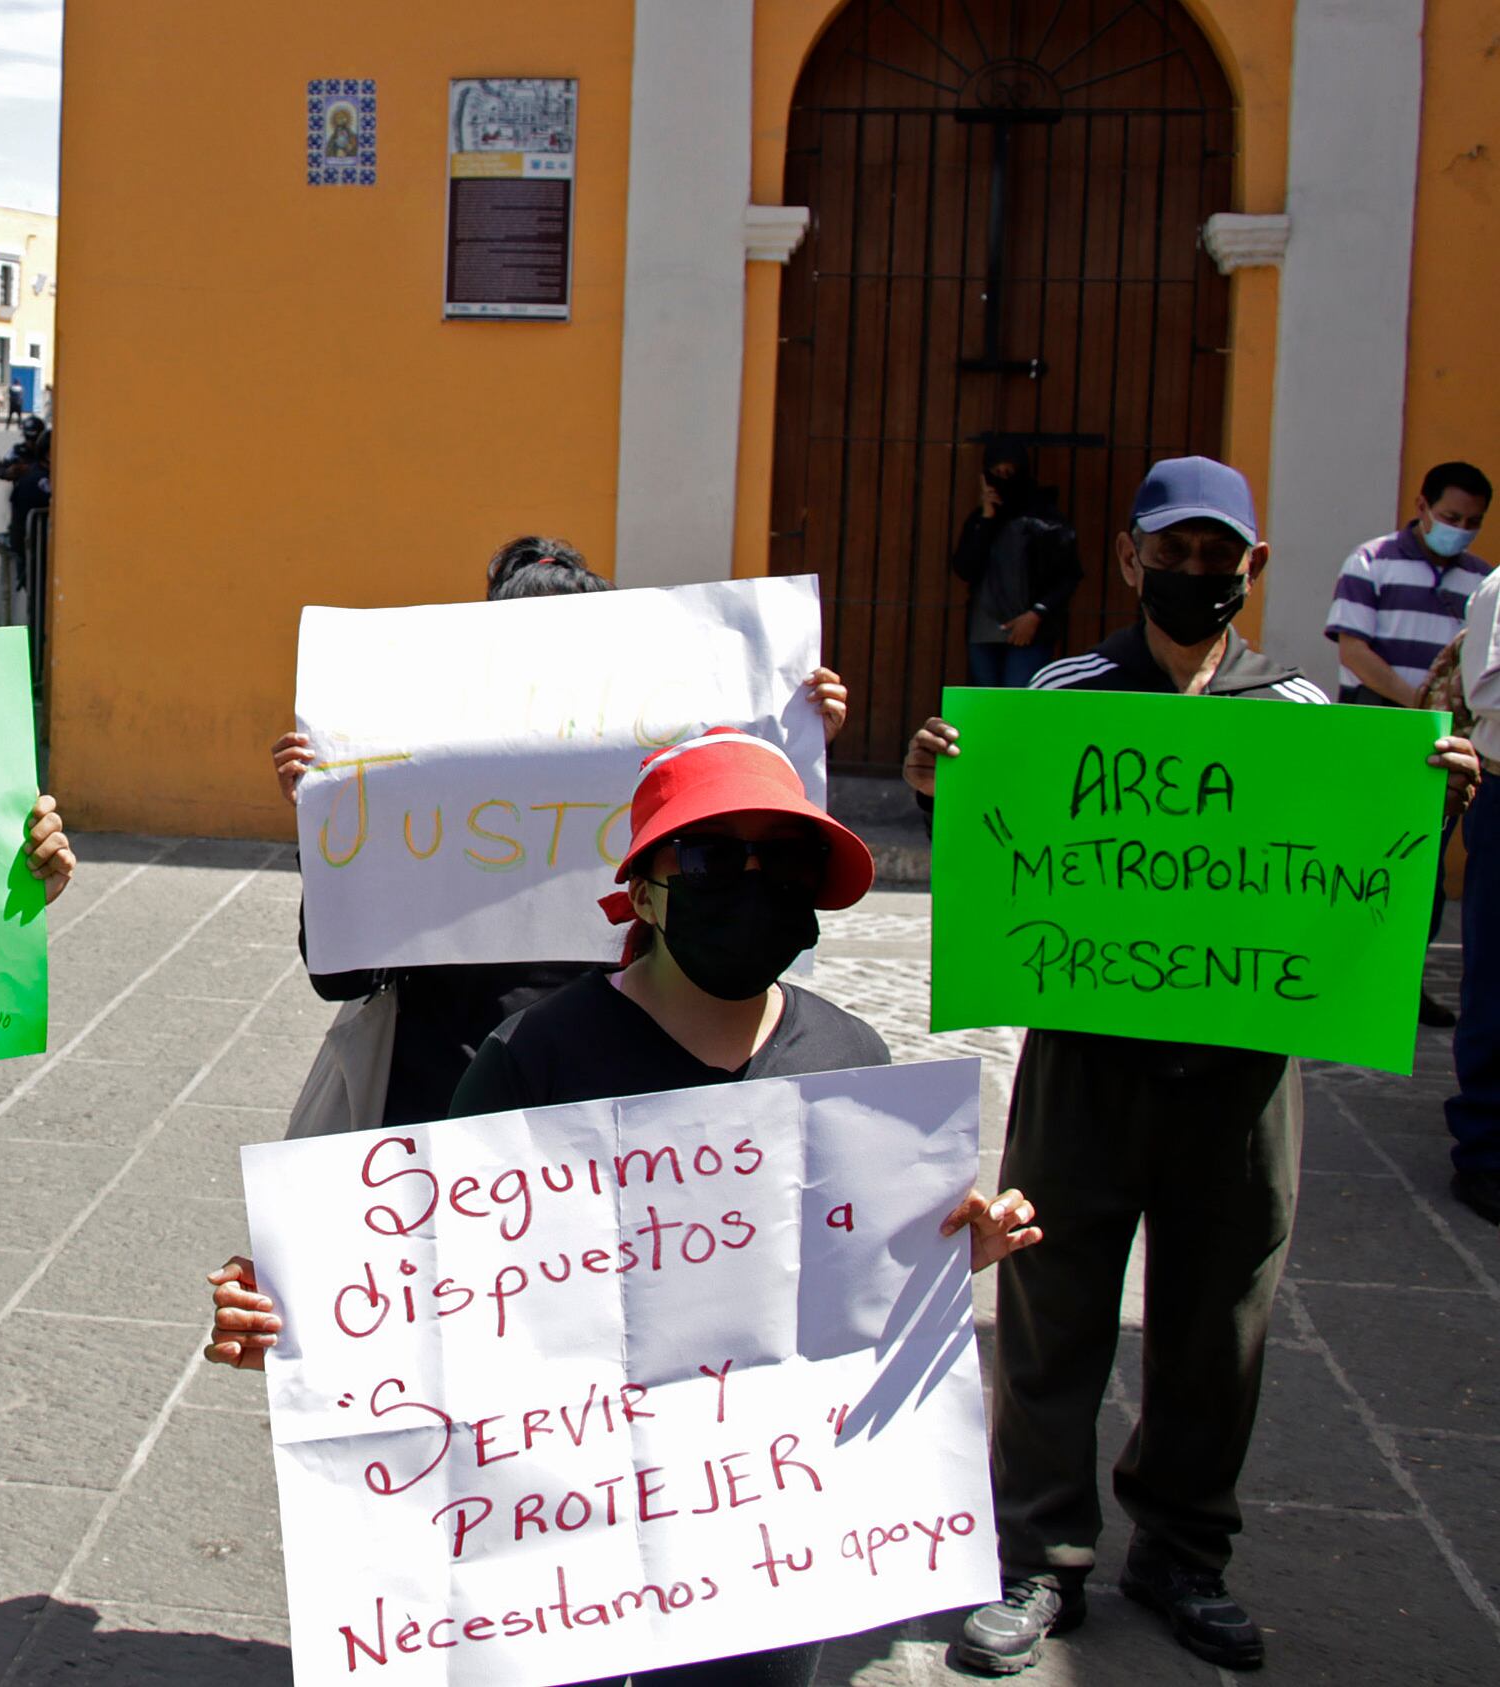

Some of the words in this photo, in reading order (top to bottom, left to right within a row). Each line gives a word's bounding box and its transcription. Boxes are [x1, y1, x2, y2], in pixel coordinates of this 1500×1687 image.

[1069, 743, 1234, 820] AREA
[1006, 920, 1318, 1001] PRESENTE
[360, 1136, 763, 1242] Seguimos
[334, 1210, 757, 1338] dispuestos
[338, 1566, 721, 1672] Necesitamos
[751, 1522, 814, 1587] tu
[839, 1510, 977, 1577] apoyo
